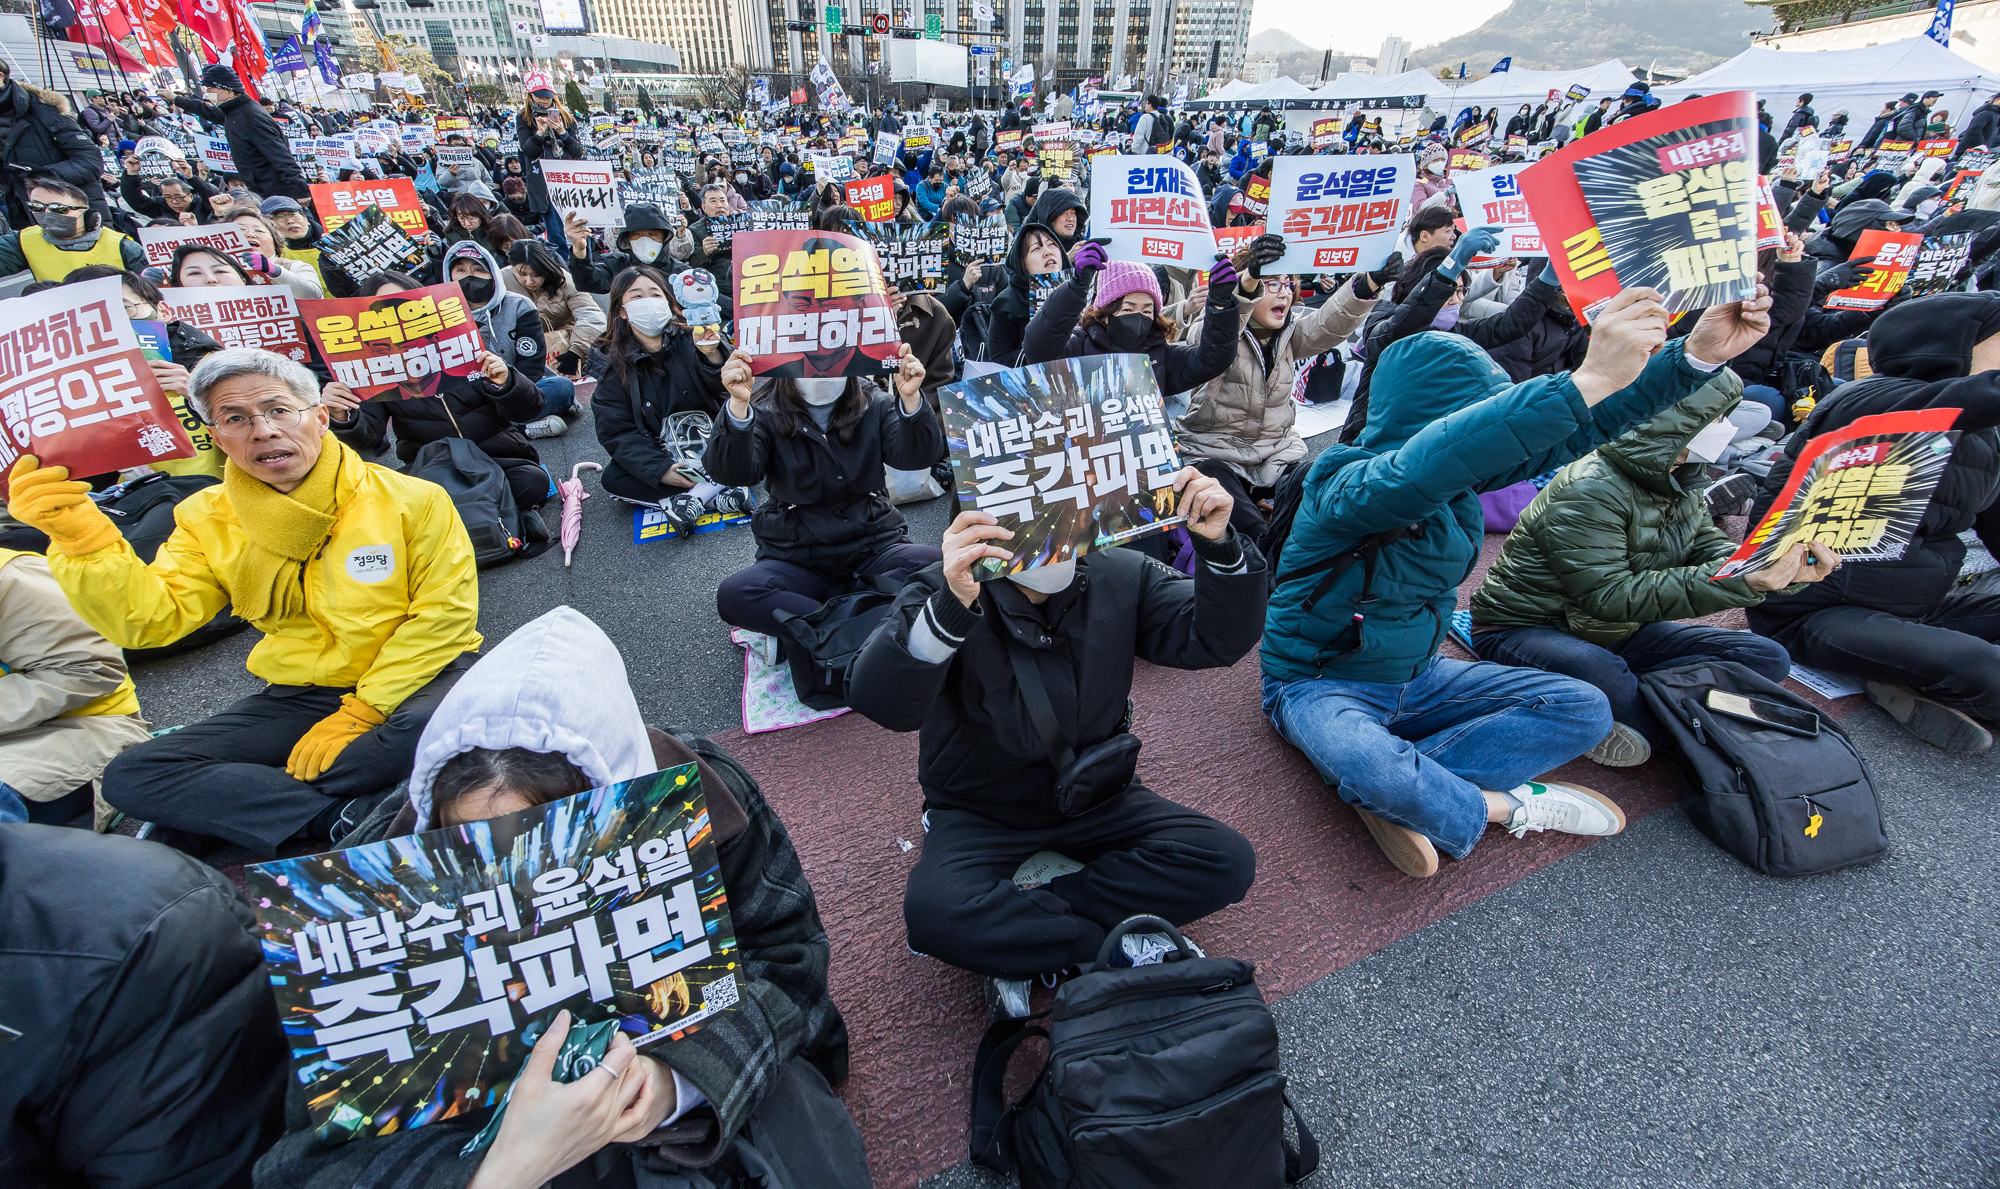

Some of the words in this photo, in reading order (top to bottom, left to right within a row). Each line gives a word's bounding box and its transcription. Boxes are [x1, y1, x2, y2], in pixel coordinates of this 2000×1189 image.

[877, 19, 886, 29] 40
[440, 154, 472, 162] 해체하라
[545, 171, 571, 183] 내란동조
[1297, 166, 1397, 201] 윤석열은
[332, 188, 398, 212] 윤석열
[623, 191, 654, 201] 내란수괴
[848, 183, 885, 205] 윤석열
[752, 212, 784, 222] 내란수괴
[786, 212, 809, 221] 윤석열
[869, 199, 894, 221] 파면!
[1111, 197, 1210, 230] 파면선고
[1283, 199, 1399, 237] 즉각파면!
[330, 241, 367, 268] 내란수괴
[359, 219, 397, 247] 윤석열
[981, 226, 1005, 238] 윤석열
[1514, 236, 1541, 250] 진보당
[905, 240, 943, 254] 윤석열
[956, 236, 1005, 257] 즉각파면
[1146, 239, 1182, 256] 진보당
[1318, 250, 1353, 264] 진보당
[740, 247, 887, 307] 윤석열을
[215, 295, 291, 323] 파면하고
[316, 294, 468, 355] 윤석열을
[0, 299, 119, 386] 파면하고
[331, 329, 482, 389] 파면하라!
[965, 403, 1096, 460] 내란수괴
[1100, 394, 1165, 434] 윤석열
[974, 427, 1182, 523] 즉각파면
[354, 554, 388, 567] 정의당
[292, 884, 522, 977] 내란수괴
[531, 828, 694, 921] 윤석열
[310, 880, 712, 1065] 즉각파면
